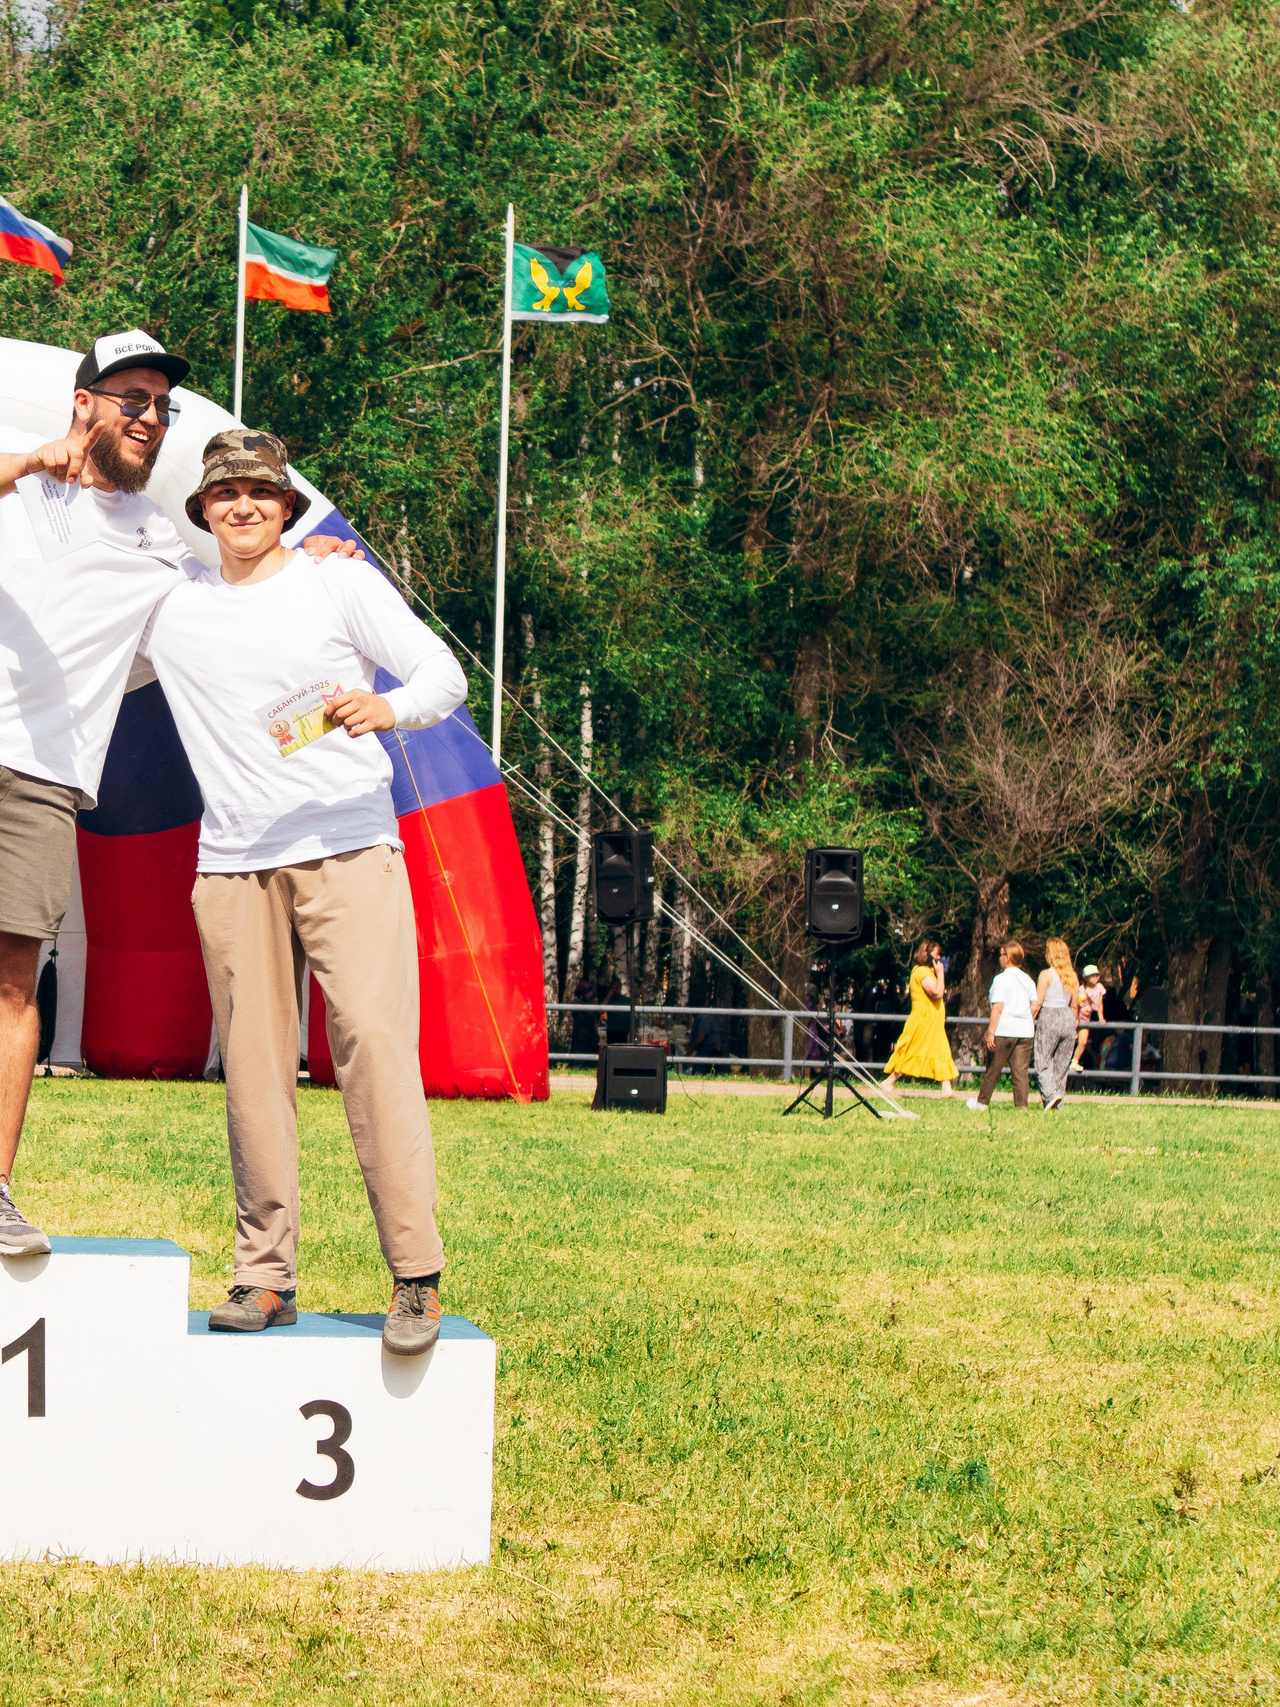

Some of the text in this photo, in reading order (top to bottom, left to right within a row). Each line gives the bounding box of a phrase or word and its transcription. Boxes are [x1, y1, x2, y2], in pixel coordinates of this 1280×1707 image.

[267, 680, 329, 719] САБАНТУЙ-2025
[275, 724, 283, 733] 3
[2, 1318, 45, 1416] 1
[296, 1400, 354, 1500] 3
